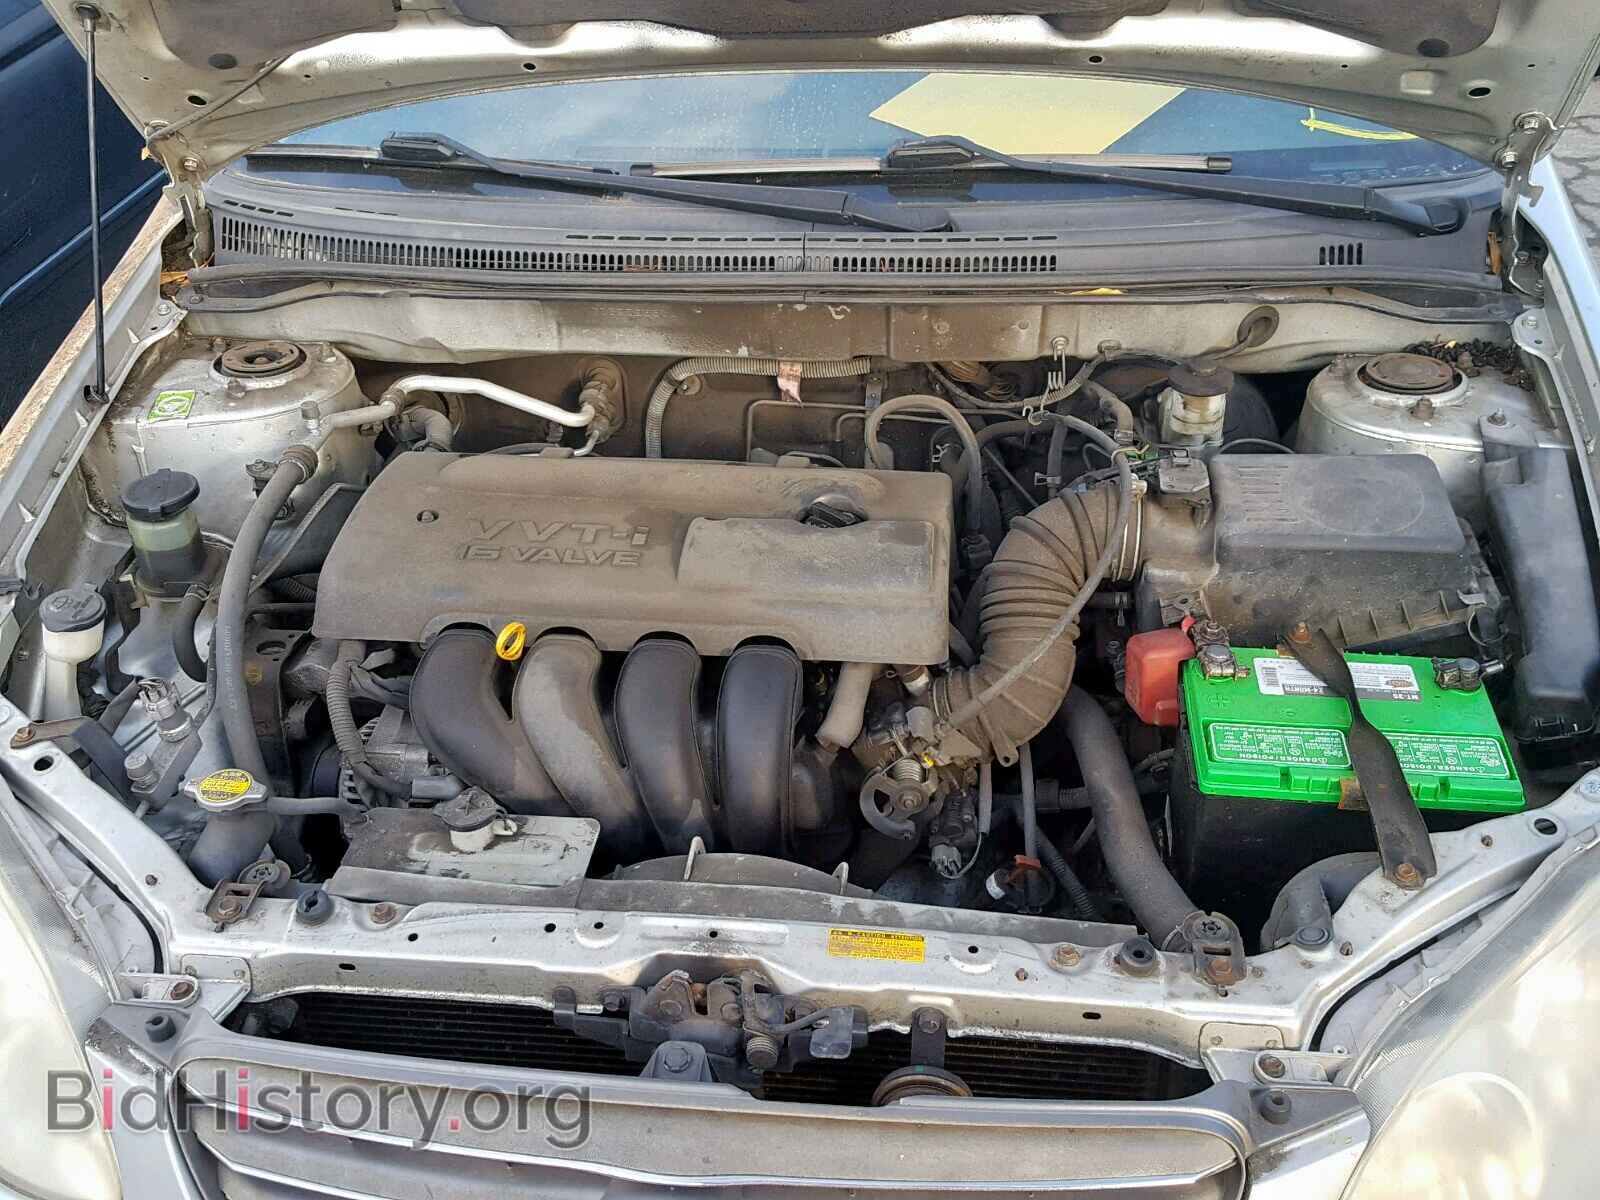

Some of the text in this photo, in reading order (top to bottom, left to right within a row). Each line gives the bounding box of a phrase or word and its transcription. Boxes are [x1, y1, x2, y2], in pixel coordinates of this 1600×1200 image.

[468, 519, 649, 547] VVT-i
[511, 547, 641, 567] VALVE
[1280, 755, 1317, 763] DANGER
[1438, 763, 1476, 771] DANGER
